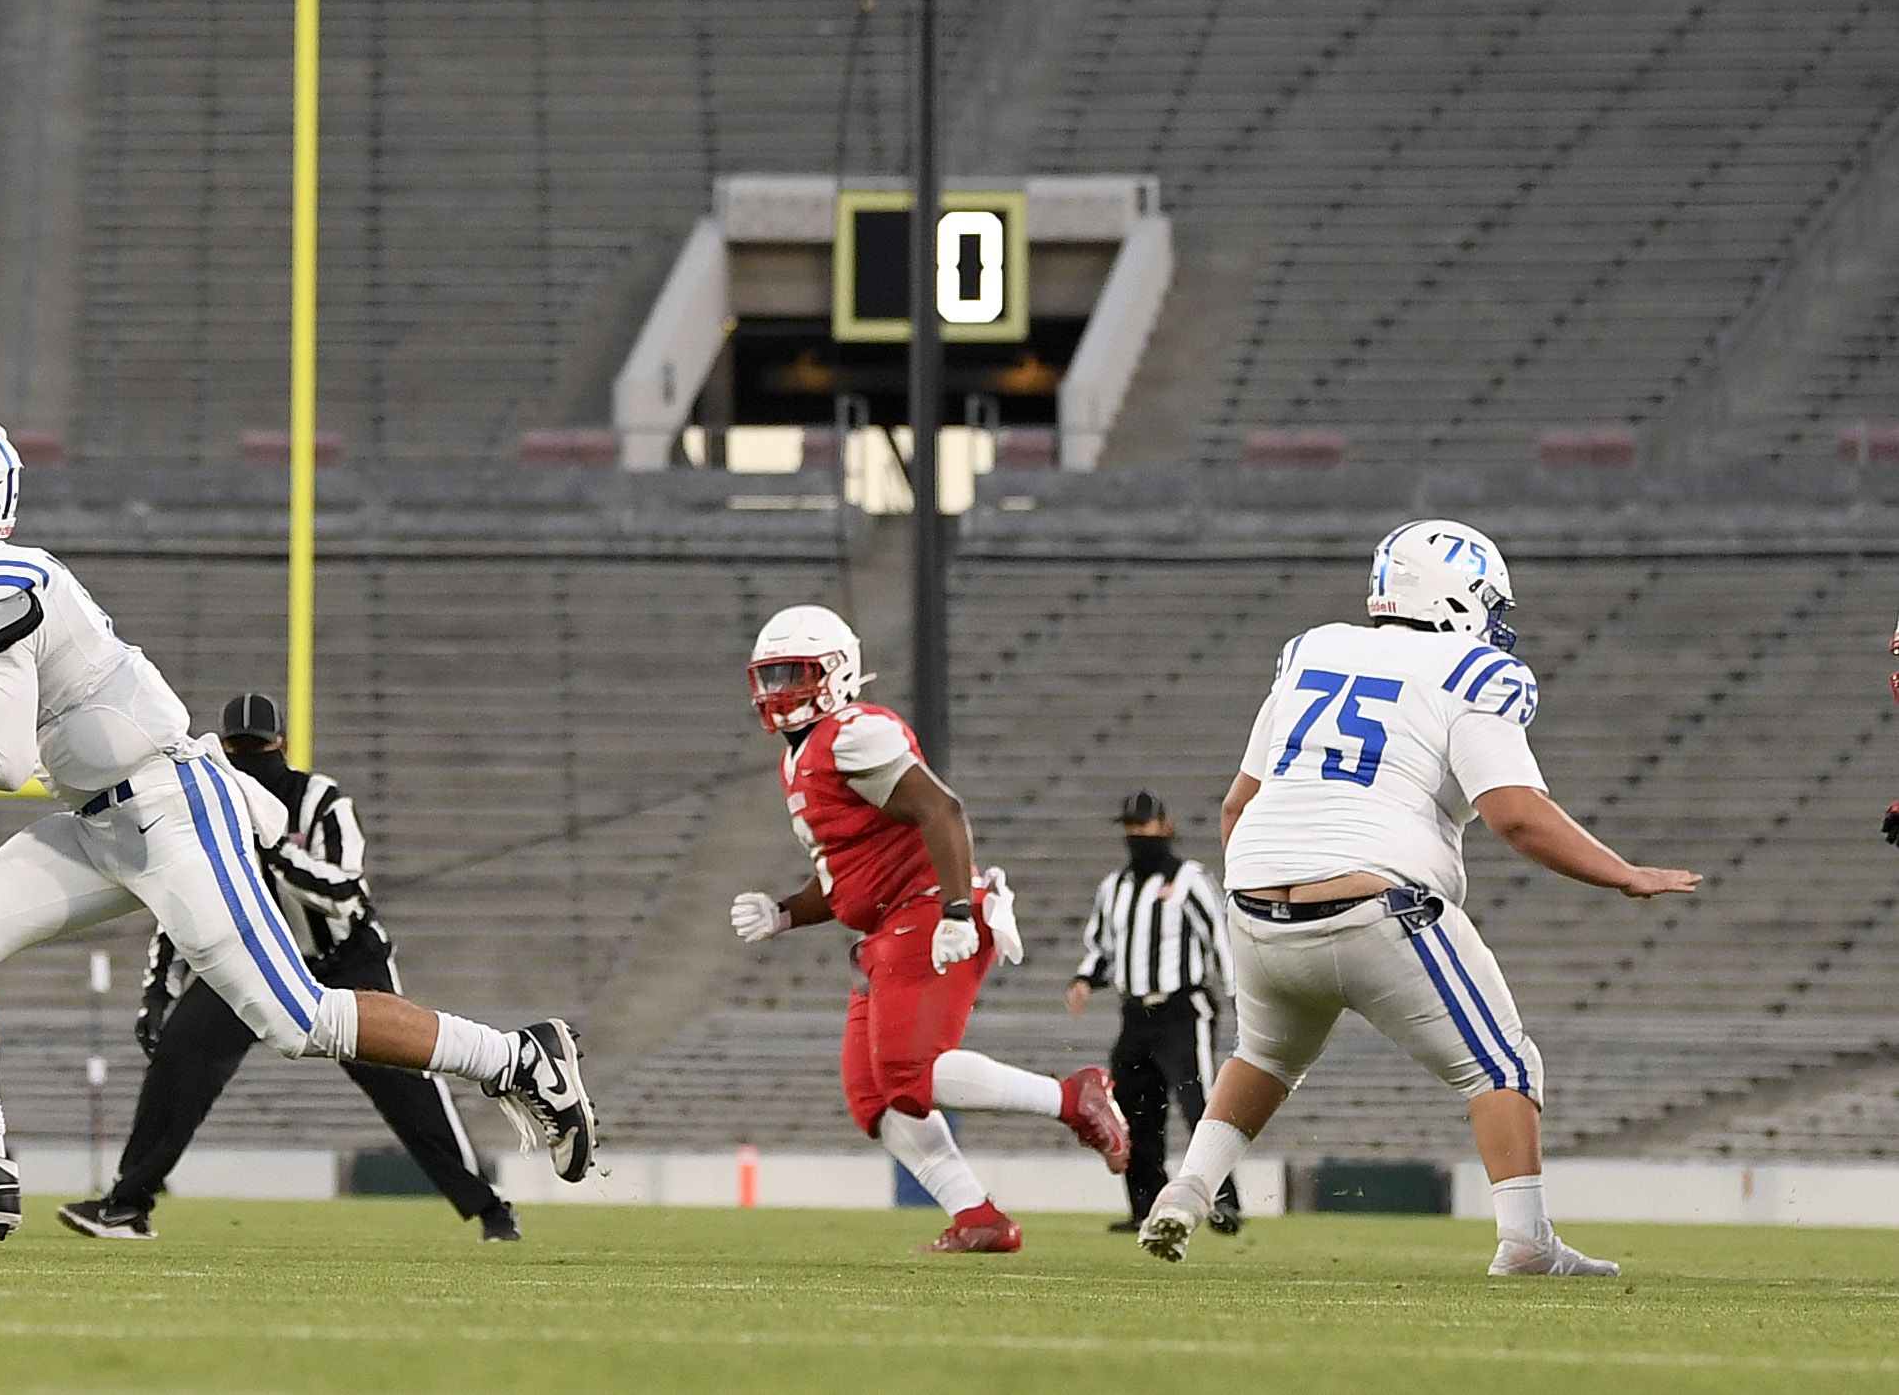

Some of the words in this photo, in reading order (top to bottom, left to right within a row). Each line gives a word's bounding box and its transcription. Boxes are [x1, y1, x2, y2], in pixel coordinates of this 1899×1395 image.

[936, 210, 1004, 324] 0
[1443, 533, 1487, 576] 75
[1273, 669, 1405, 788] 75
[1502, 677, 1538, 724] 75
